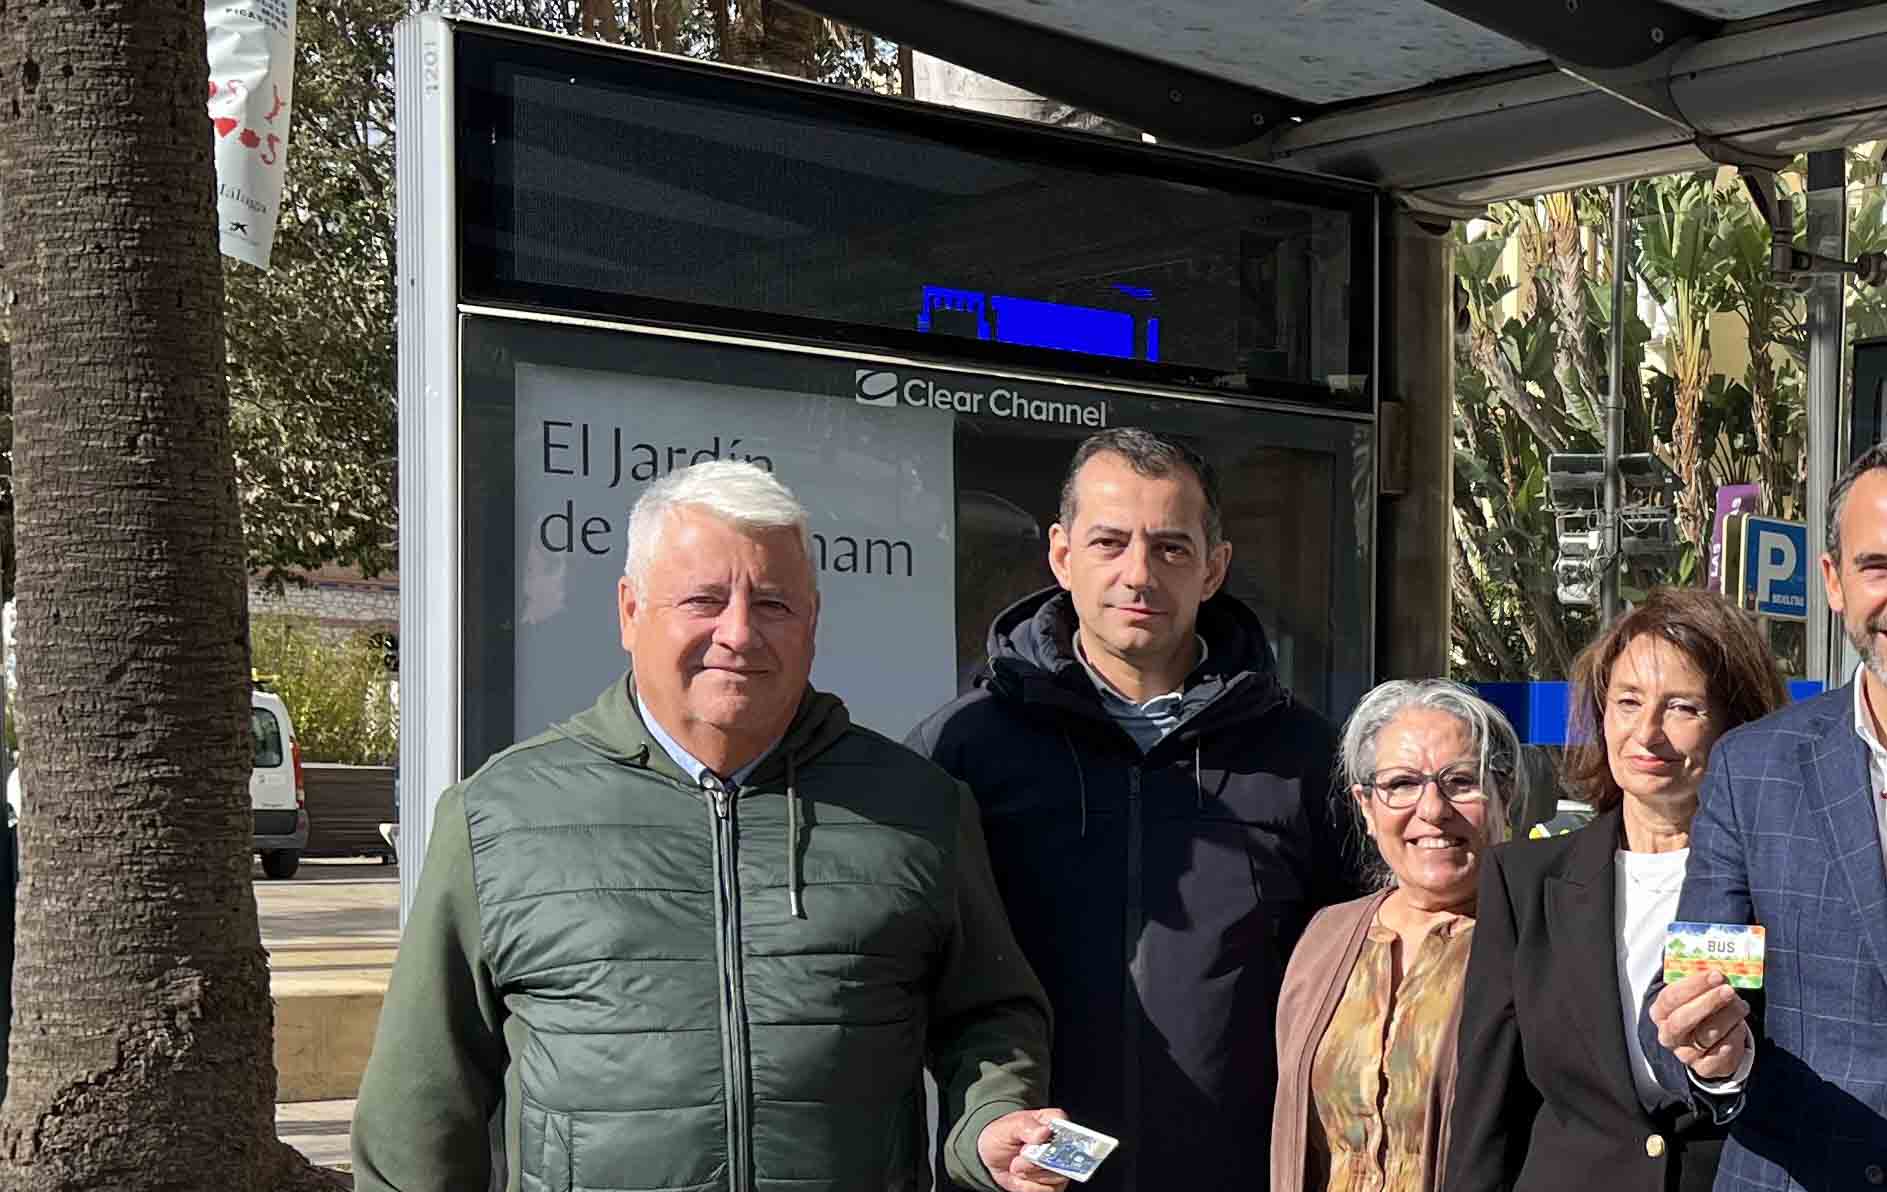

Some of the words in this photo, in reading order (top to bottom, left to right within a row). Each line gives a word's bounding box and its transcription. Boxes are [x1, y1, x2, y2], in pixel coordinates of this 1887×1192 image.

[903, 378, 984, 414] Clear
[989, 388, 1106, 427] Channel
[543, 420, 589, 477] El
[540, 500, 613, 554] de
[1758, 530, 1797, 603] P
[1707, 940, 1735, 953] BUS
